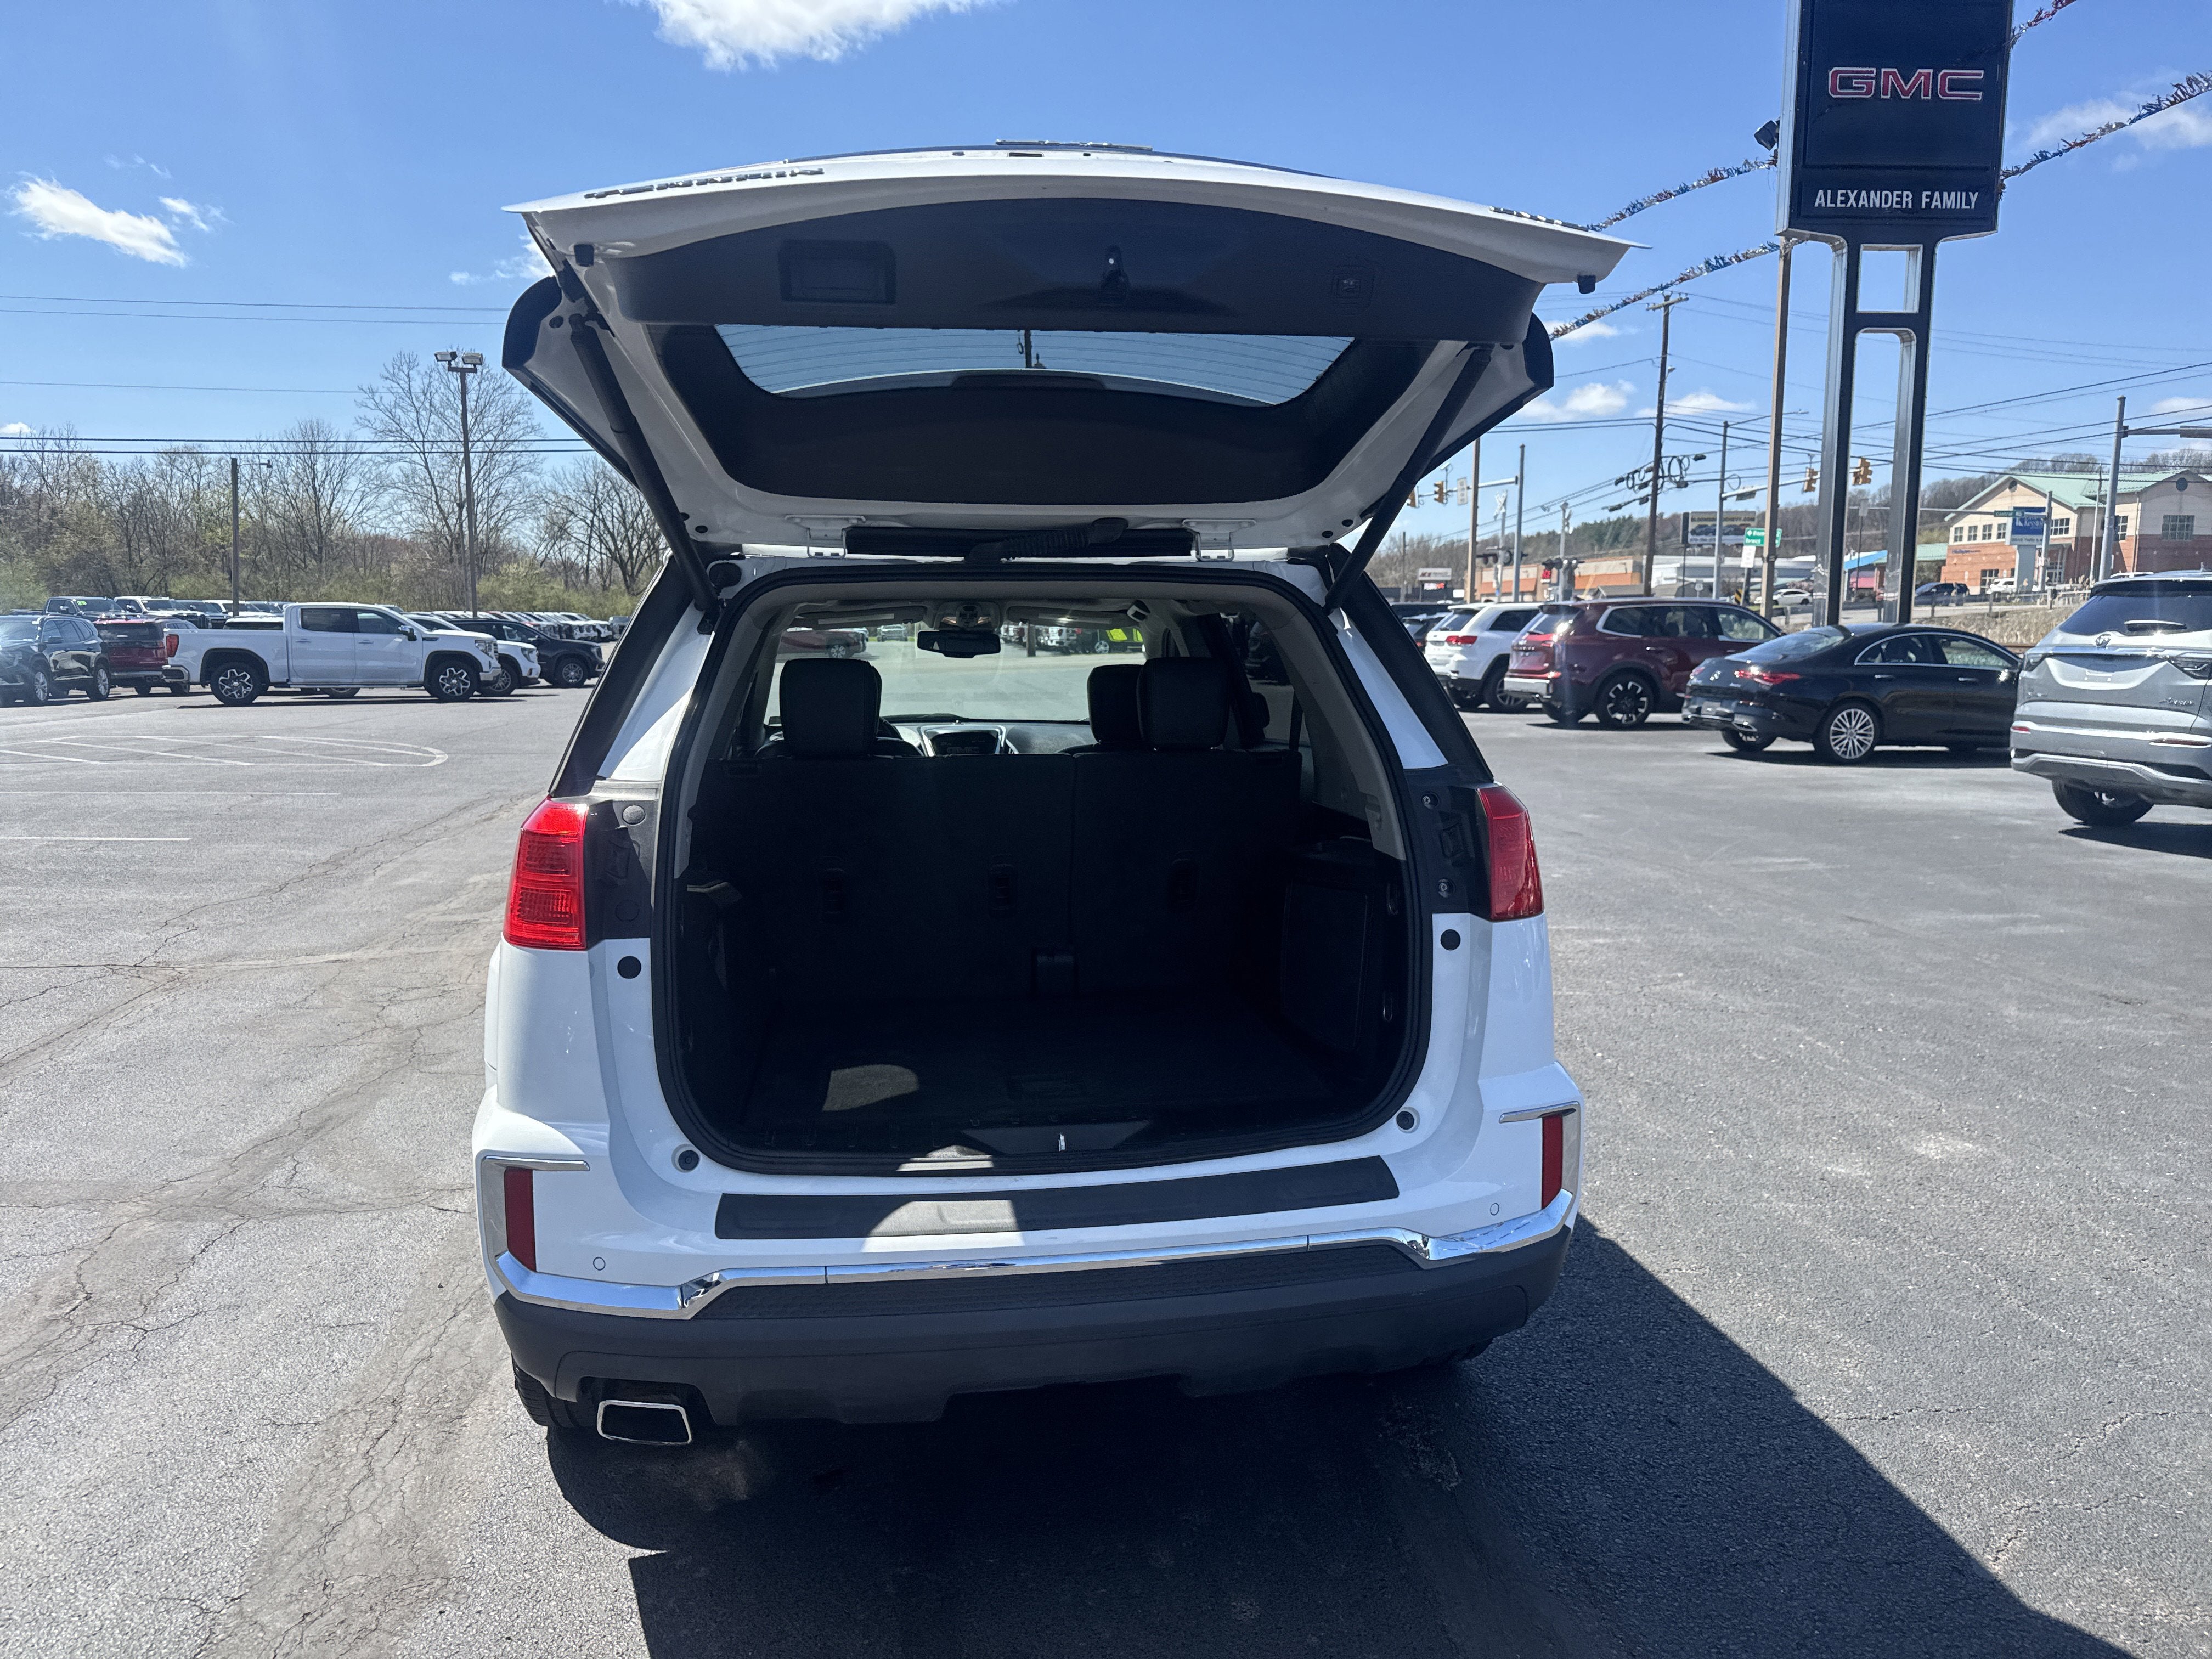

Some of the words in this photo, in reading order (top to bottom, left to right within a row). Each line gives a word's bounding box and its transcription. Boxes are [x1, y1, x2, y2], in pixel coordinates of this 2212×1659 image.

[1829, 67, 1984, 101] GMC
[1814, 189, 1913, 209] ALEXANDER
[1921, 190, 1979, 210] FAMILY
